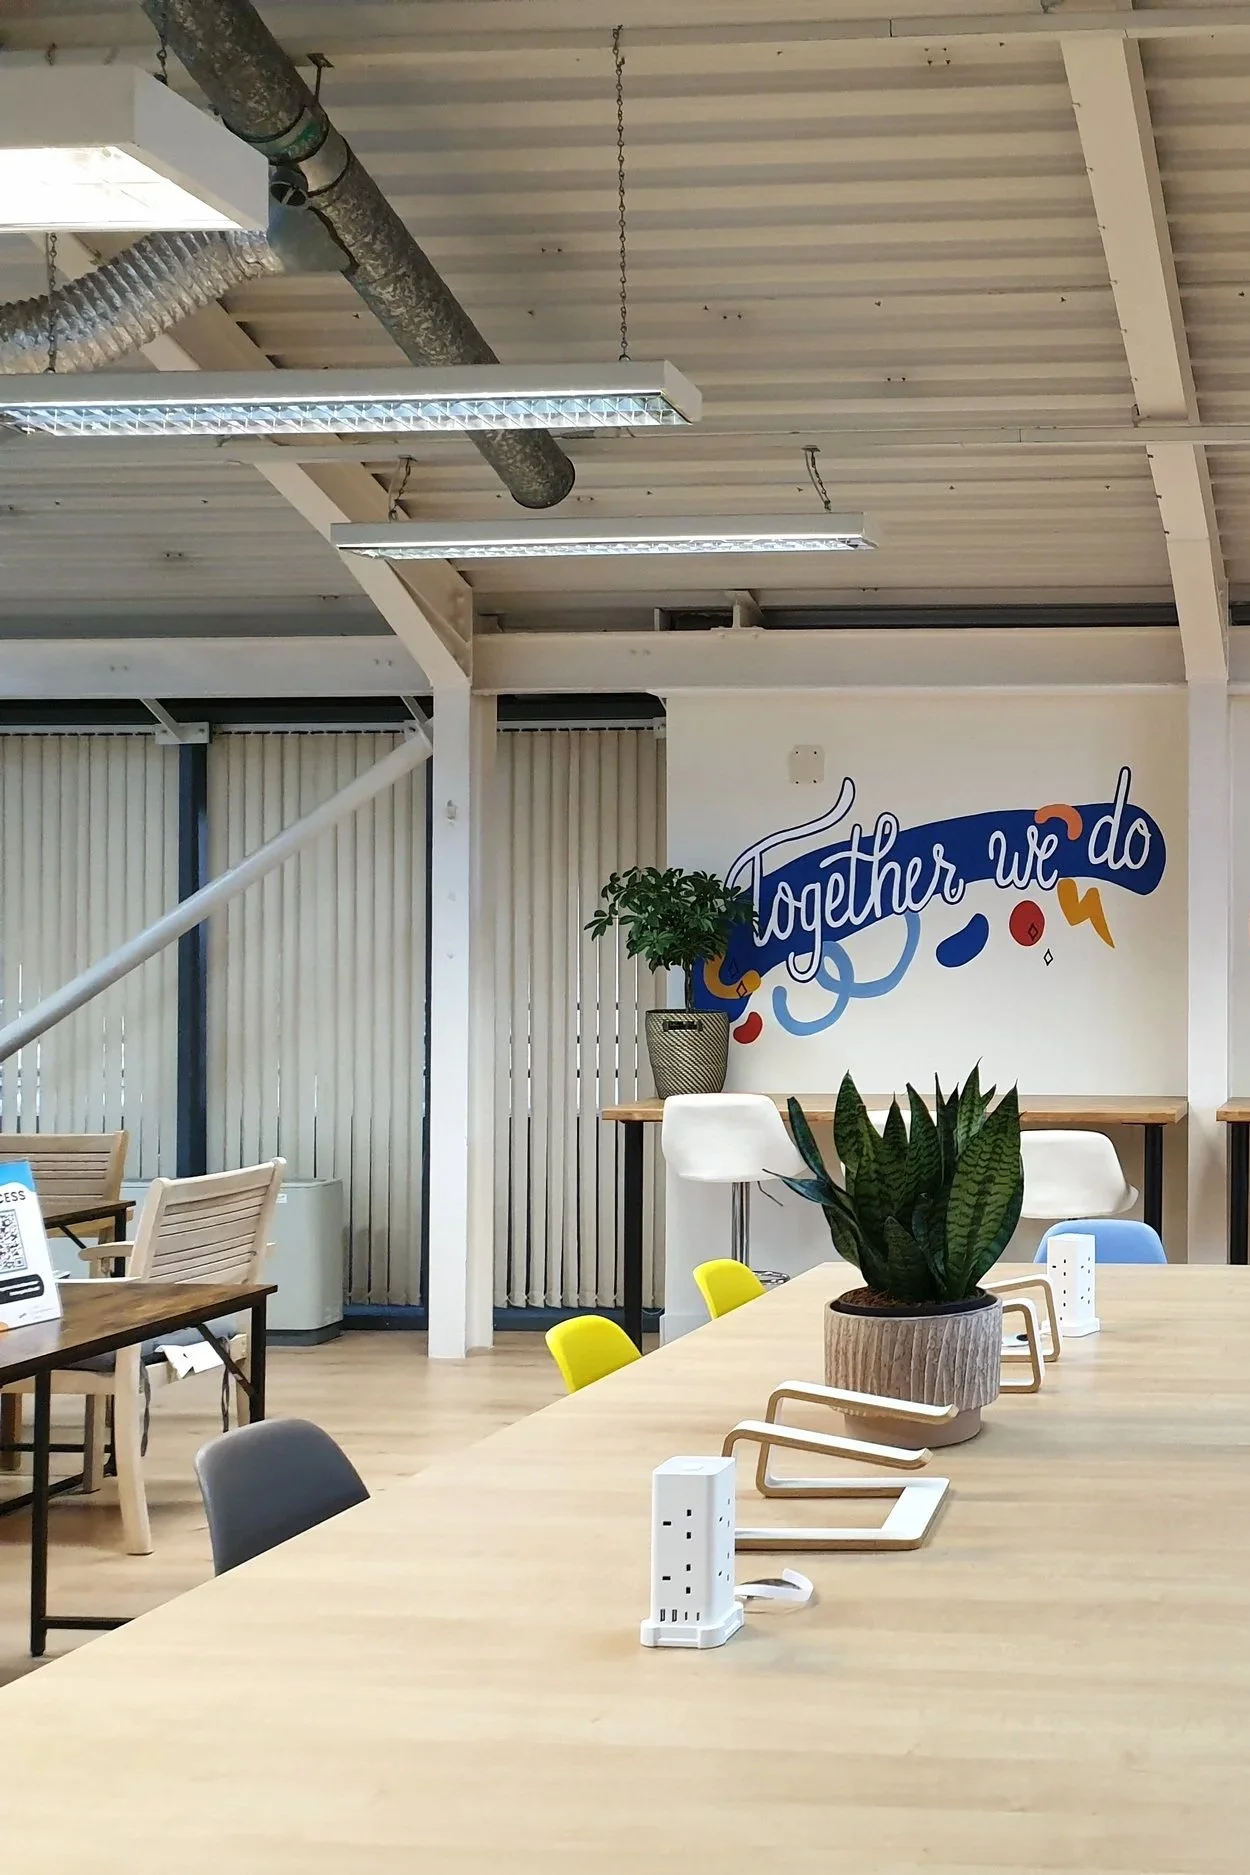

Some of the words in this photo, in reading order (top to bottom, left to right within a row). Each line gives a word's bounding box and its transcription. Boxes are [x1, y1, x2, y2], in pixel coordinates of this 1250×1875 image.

[725, 777, 965, 983] Together
[988, 825, 1059, 890] we
[1088, 766, 1152, 870] do
